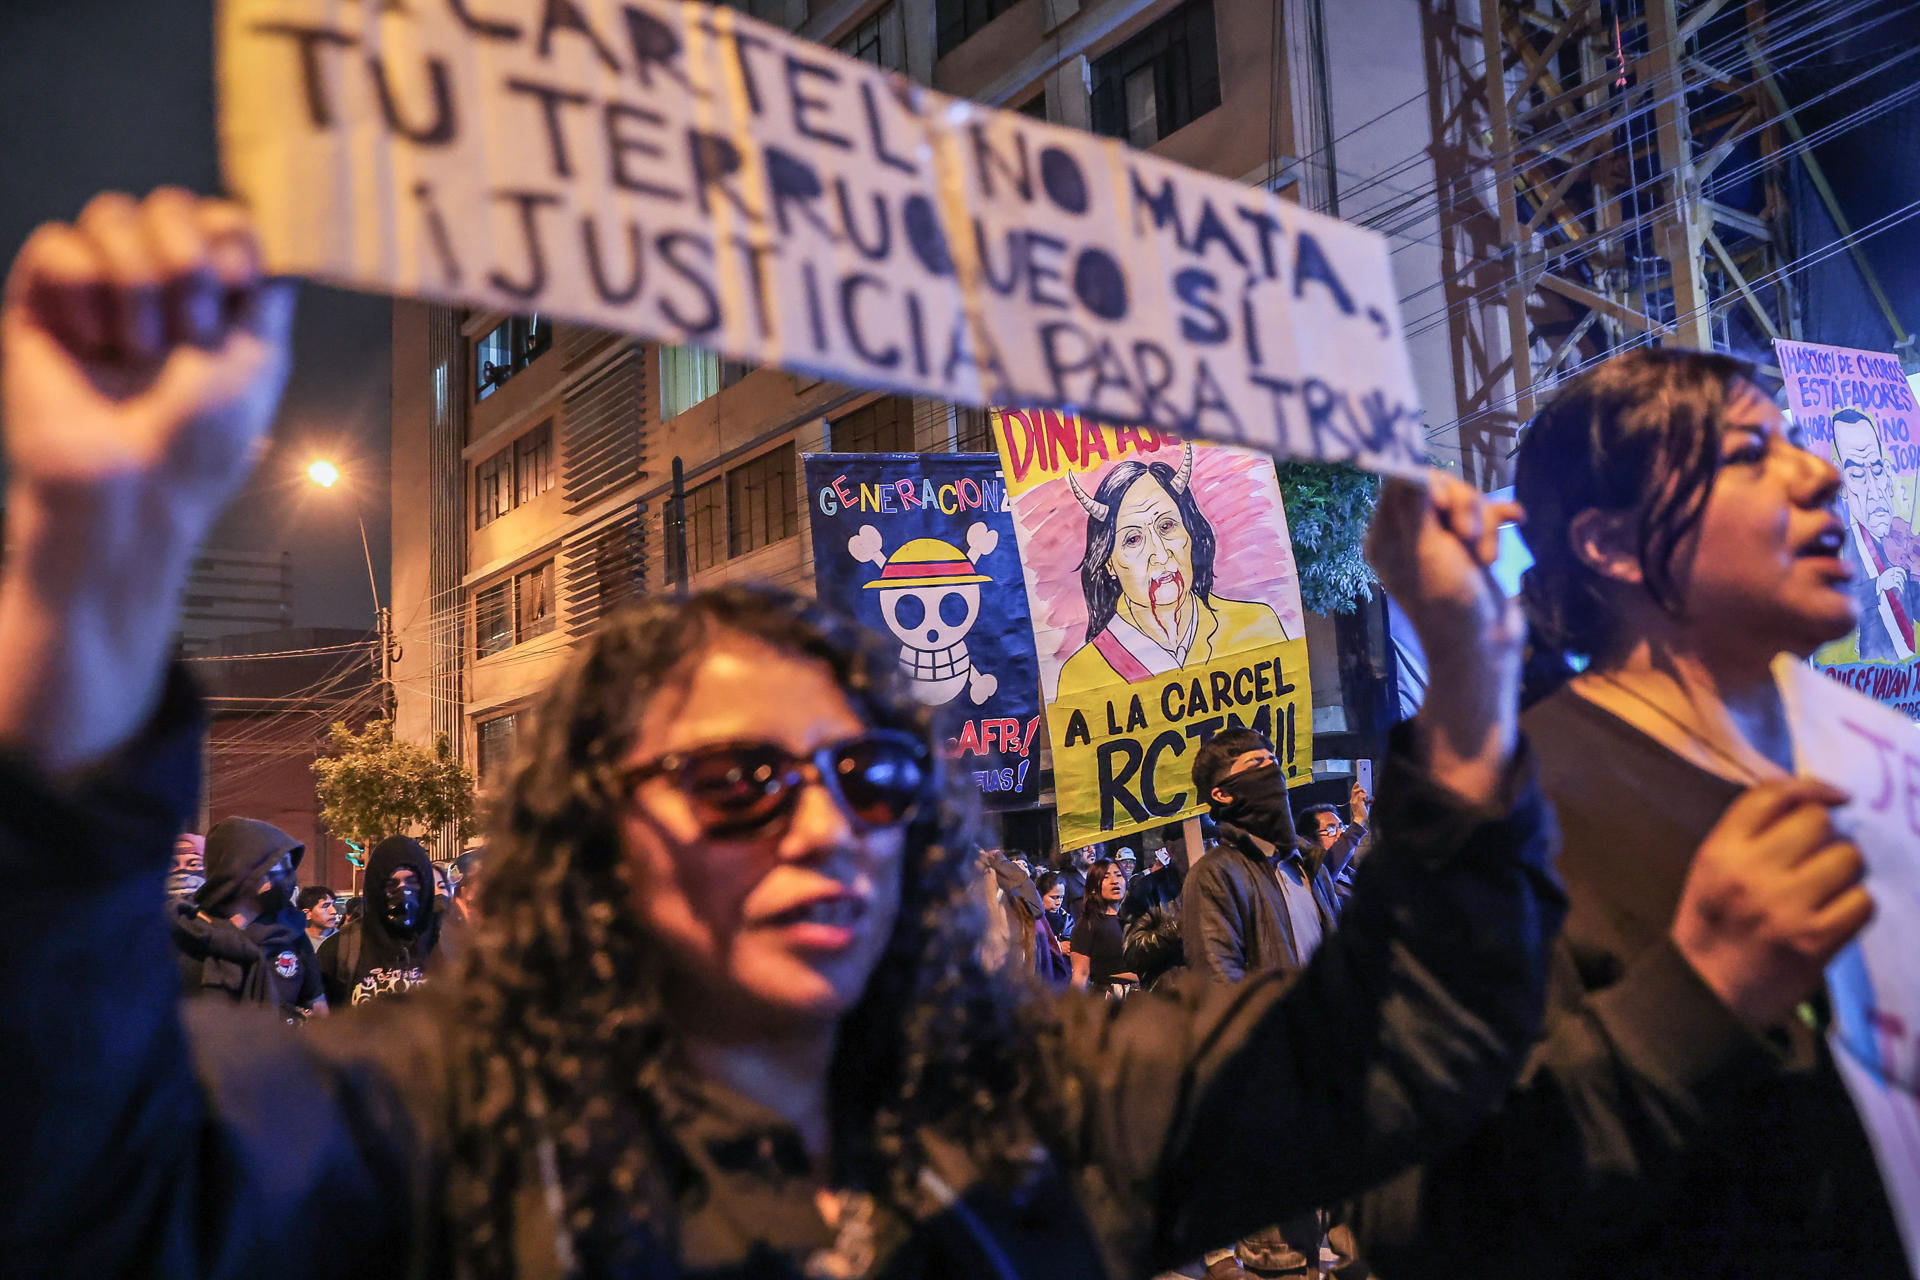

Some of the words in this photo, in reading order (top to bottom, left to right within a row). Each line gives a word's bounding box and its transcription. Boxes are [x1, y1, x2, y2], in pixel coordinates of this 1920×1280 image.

[252, 22, 458, 148] TU
[969, 120, 1091, 217] NO
[1038, 319, 1228, 441] PARA
[1838, 354, 1855, 375] DE
[1857, 354, 1908, 385] CHOROS
[1001, 407, 1110, 483] DINA
[819, 474, 999, 516] GENERACION
[1065, 709, 1091, 748] A
[1107, 693, 1149, 736] LA
[1161, 657, 1296, 723] CARCEL
